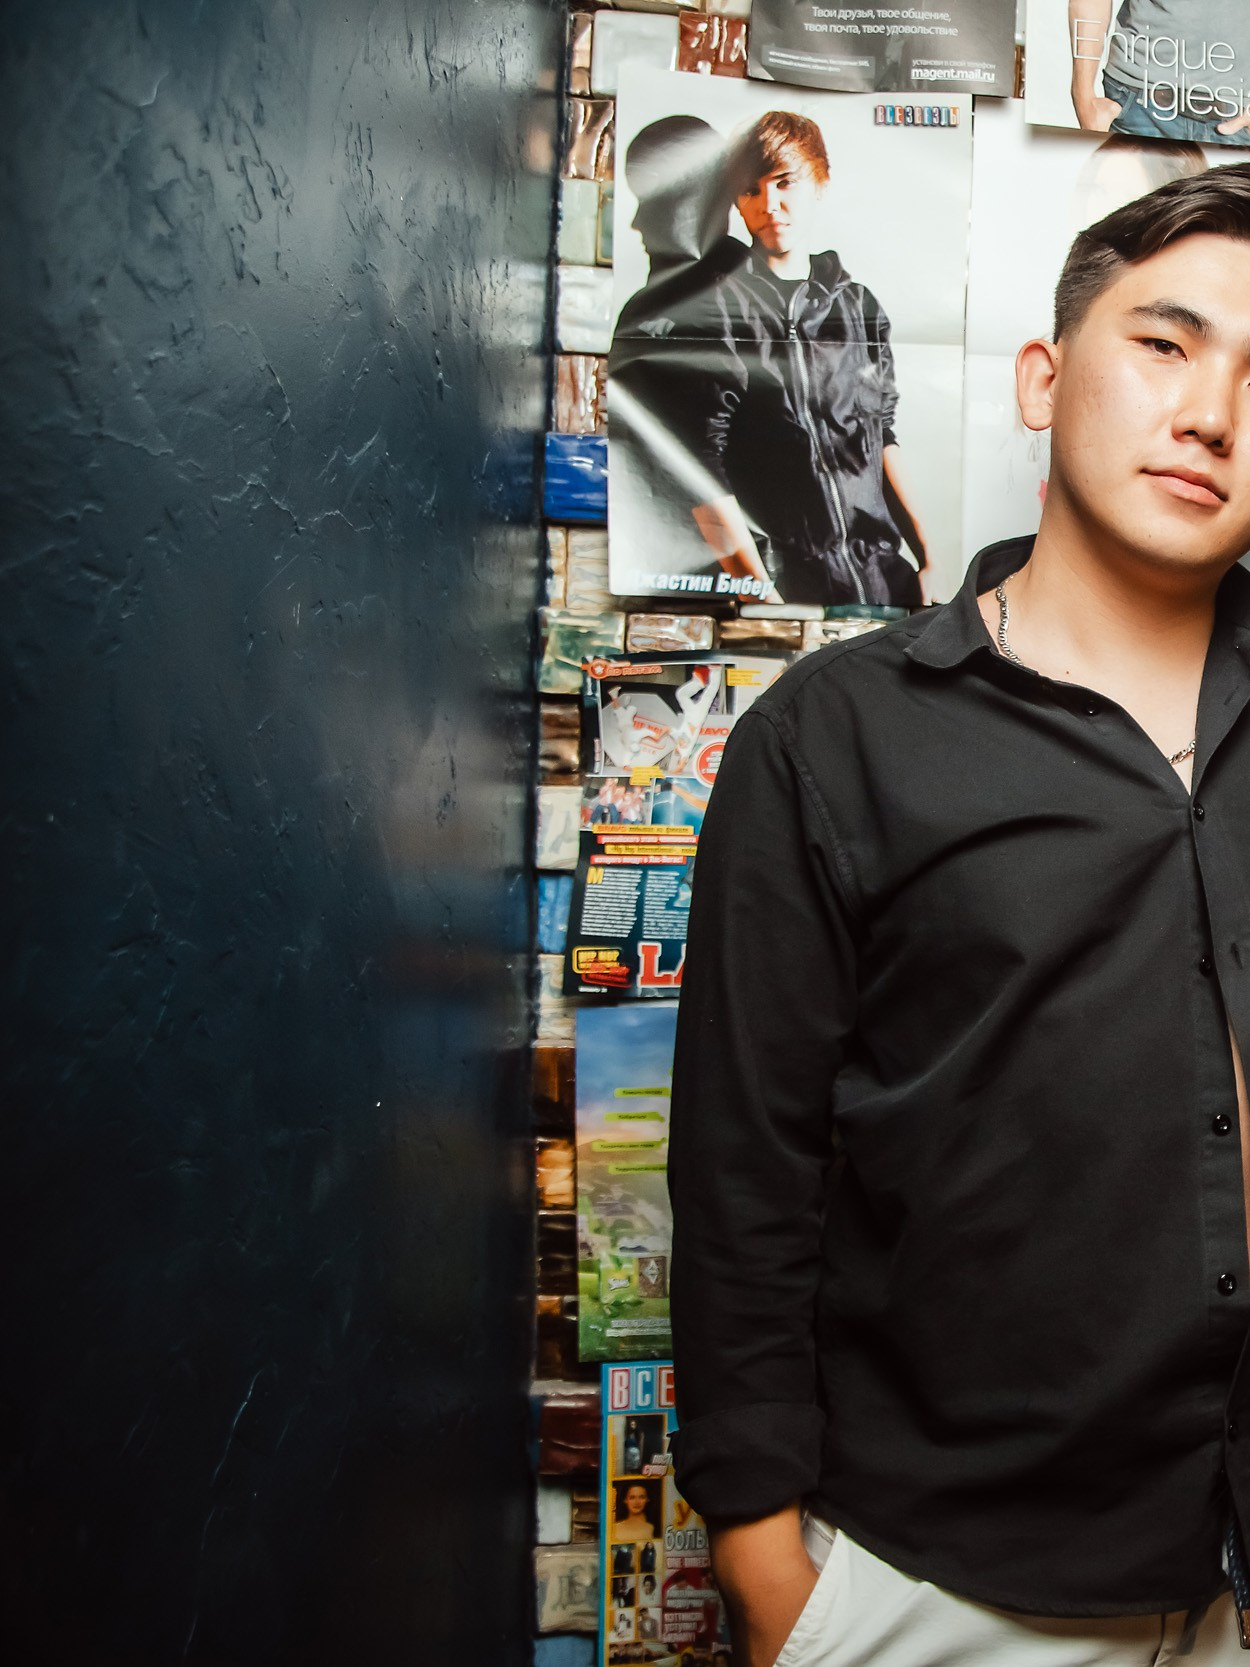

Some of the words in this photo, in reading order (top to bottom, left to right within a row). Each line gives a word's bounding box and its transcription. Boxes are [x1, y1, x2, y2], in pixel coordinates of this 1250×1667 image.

[812, 6, 837, 18] Твои
[838, 9, 875, 21] друзья,
[877, 9, 900, 19] твое
[901, 8, 951, 22] общение,
[804, 22, 828, 33] твоя
[829, 24, 860, 35] почта,
[862, 25, 885, 34] твое
[886, 25, 958, 37] удовольствие
[1073, 18, 1236, 77] Enrique
[912, 59, 943, 67] установи
[911, 68, 995, 83] magent.mail.ru
[715, 571, 775, 600] Бибер
[699, 727, 731, 737] AVO
[665, 1525, 710, 1551] боль
